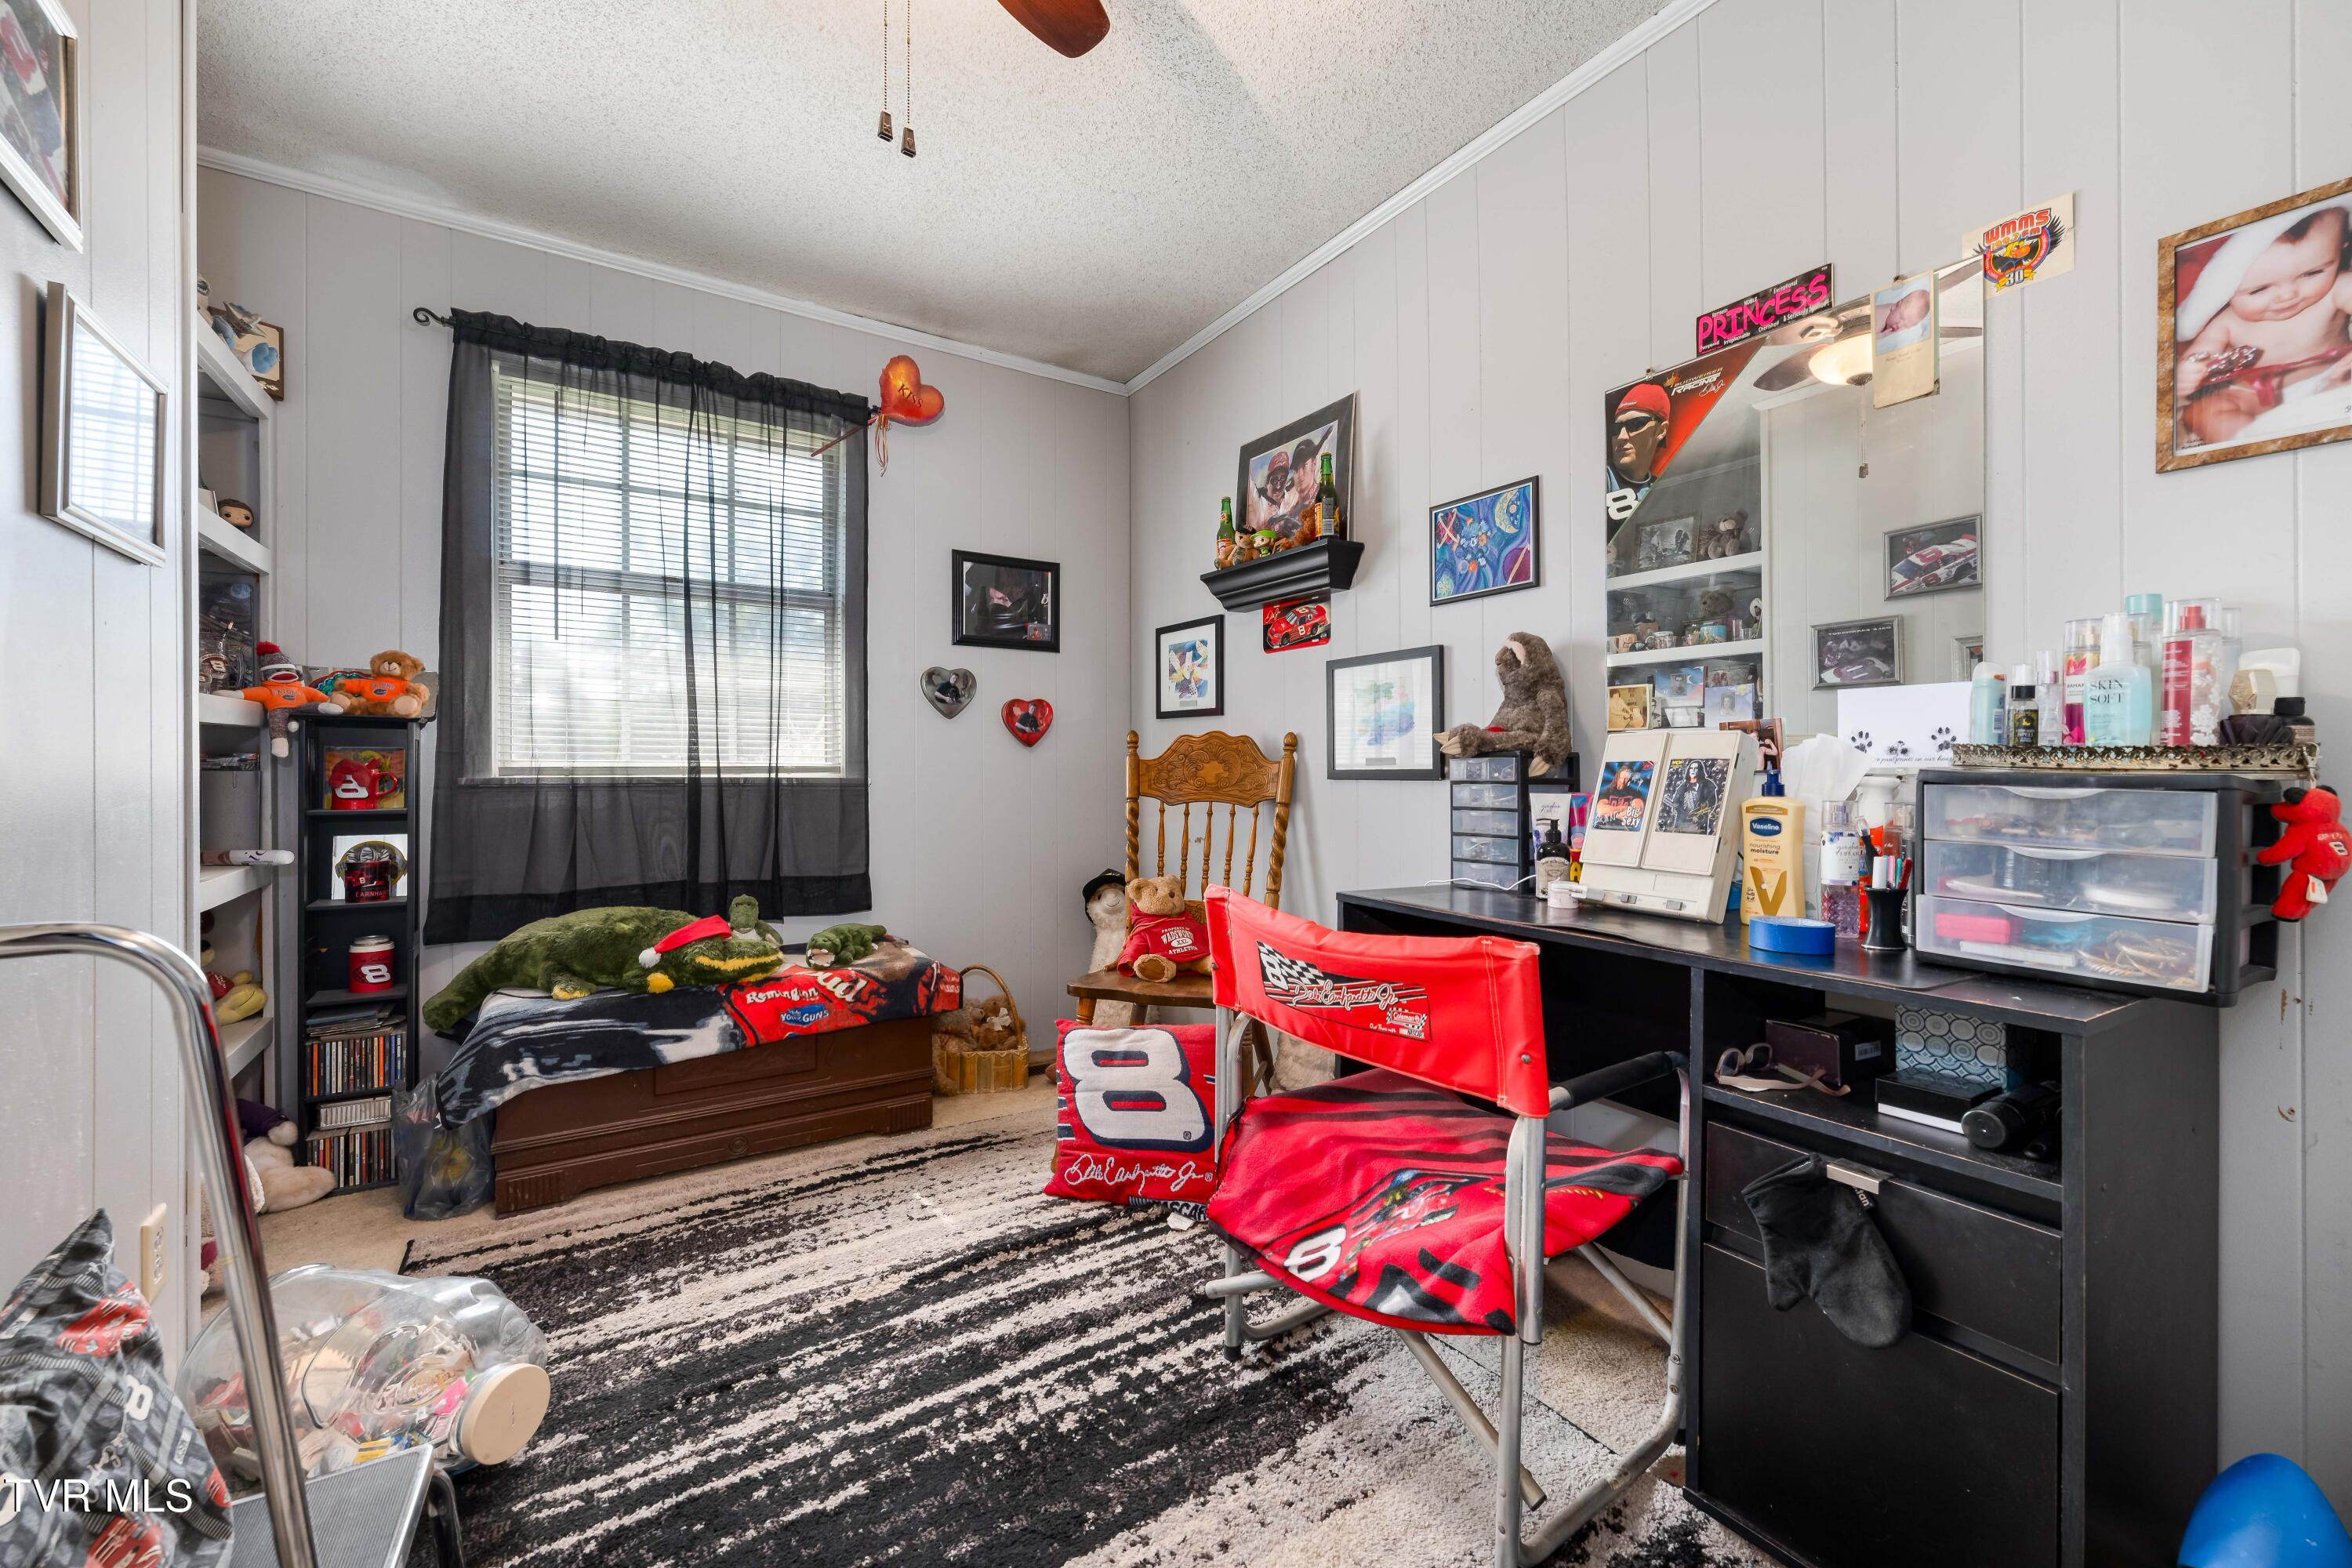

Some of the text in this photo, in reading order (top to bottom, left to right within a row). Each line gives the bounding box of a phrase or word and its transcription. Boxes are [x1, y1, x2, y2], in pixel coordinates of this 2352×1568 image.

[1984, 208, 2051, 245] WMMS
[2005, 269, 2024, 287] 30
[1698, 274, 1828, 353] PRINCESS
[1671, 372, 1722, 397] RACING
[898, 383, 924, 408] KISS
[1606, 488, 1640, 521] 8
[1298, 625, 1306, 636] 8
[2089, 679, 2123, 690] SKIN
[2089, 693, 2125, 703] SOFT
[1621, 816, 1640, 827] Sexy
[1627, 806, 1640, 818] Big
[1751, 822, 1780, 831] Vaseline
[2328, 840, 2349, 856] 8
[1749, 866, 1788, 916] V
[361, 964, 391, 983] 8
[1260, 953, 1290, 993] 8
[746, 987, 818, 1004] Remington
[1287, 978, 1322, 1006] Dale
[802, 1009, 829, 1022] GUNS
[1393, 1012, 1415, 1022] Coleman
[1063, 1028, 1215, 1152] 8
[1065, 1153, 1104, 1185] Dale
[1159, 1200, 1207, 1221] SCAR
[1283, 1224, 1347, 1282] 8
